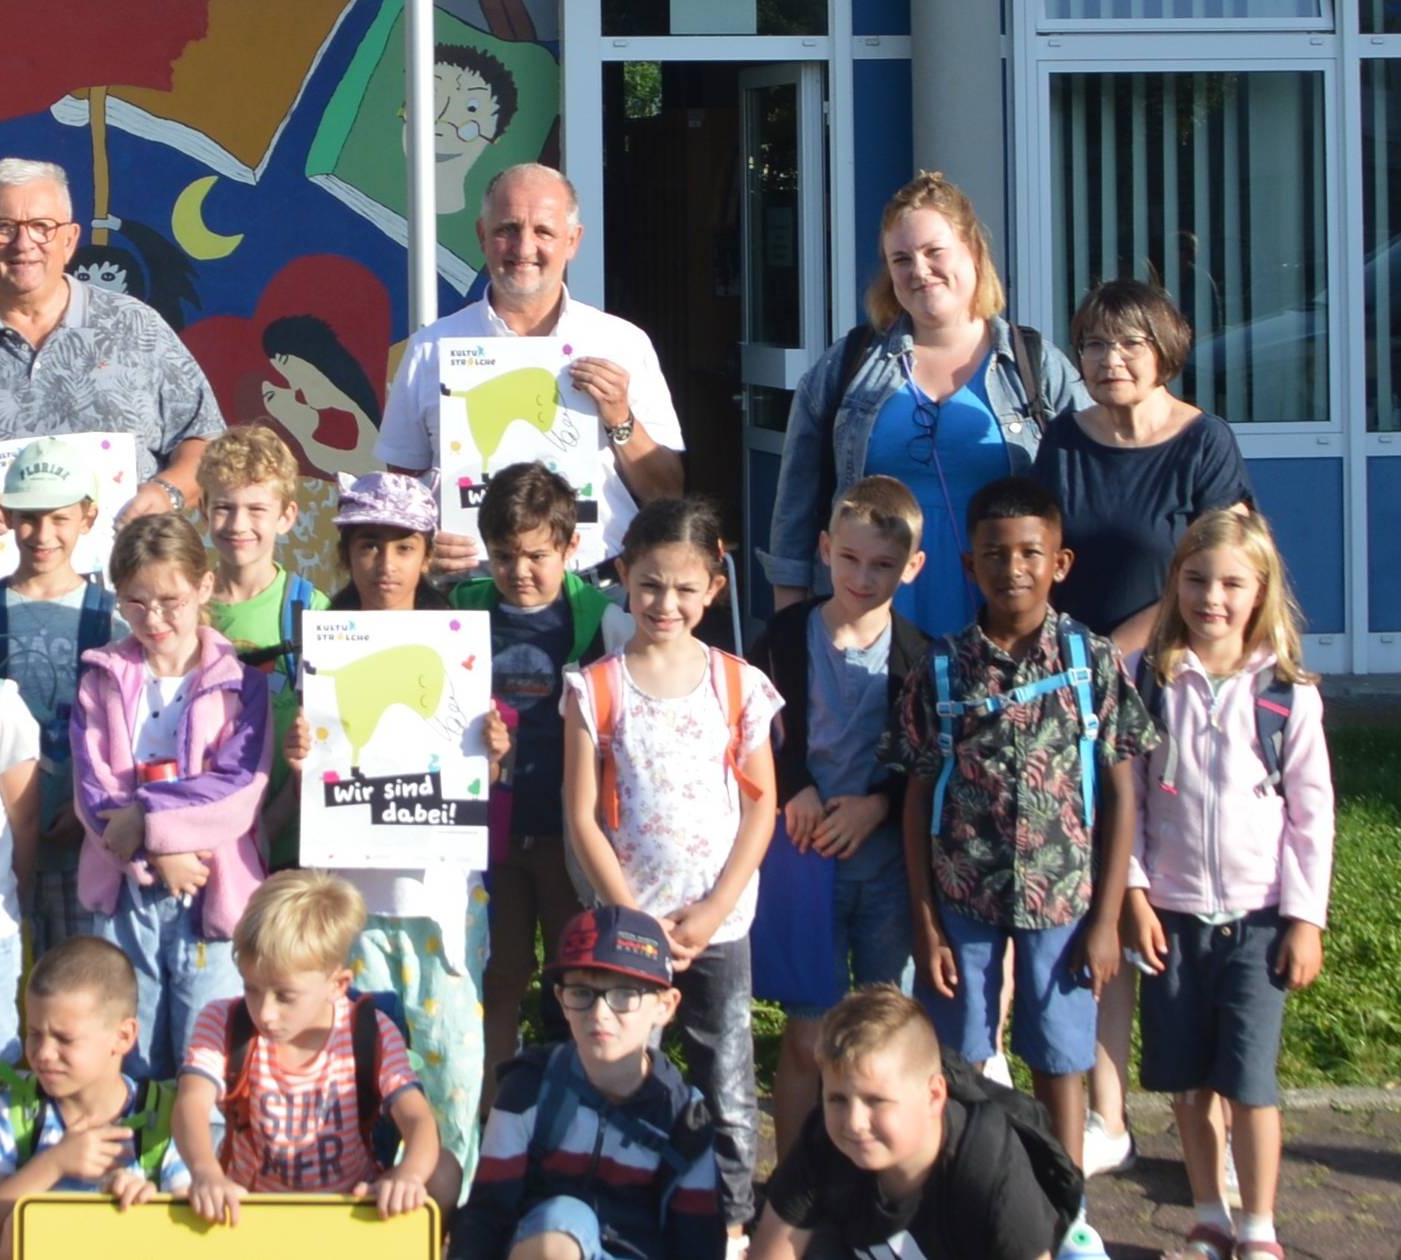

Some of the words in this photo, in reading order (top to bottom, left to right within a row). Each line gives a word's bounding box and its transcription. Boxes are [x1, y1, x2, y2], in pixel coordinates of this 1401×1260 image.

[333, 782, 375, 803] Wir
[384, 775, 434, 800] sind
[381, 802, 458, 825] dabei!
